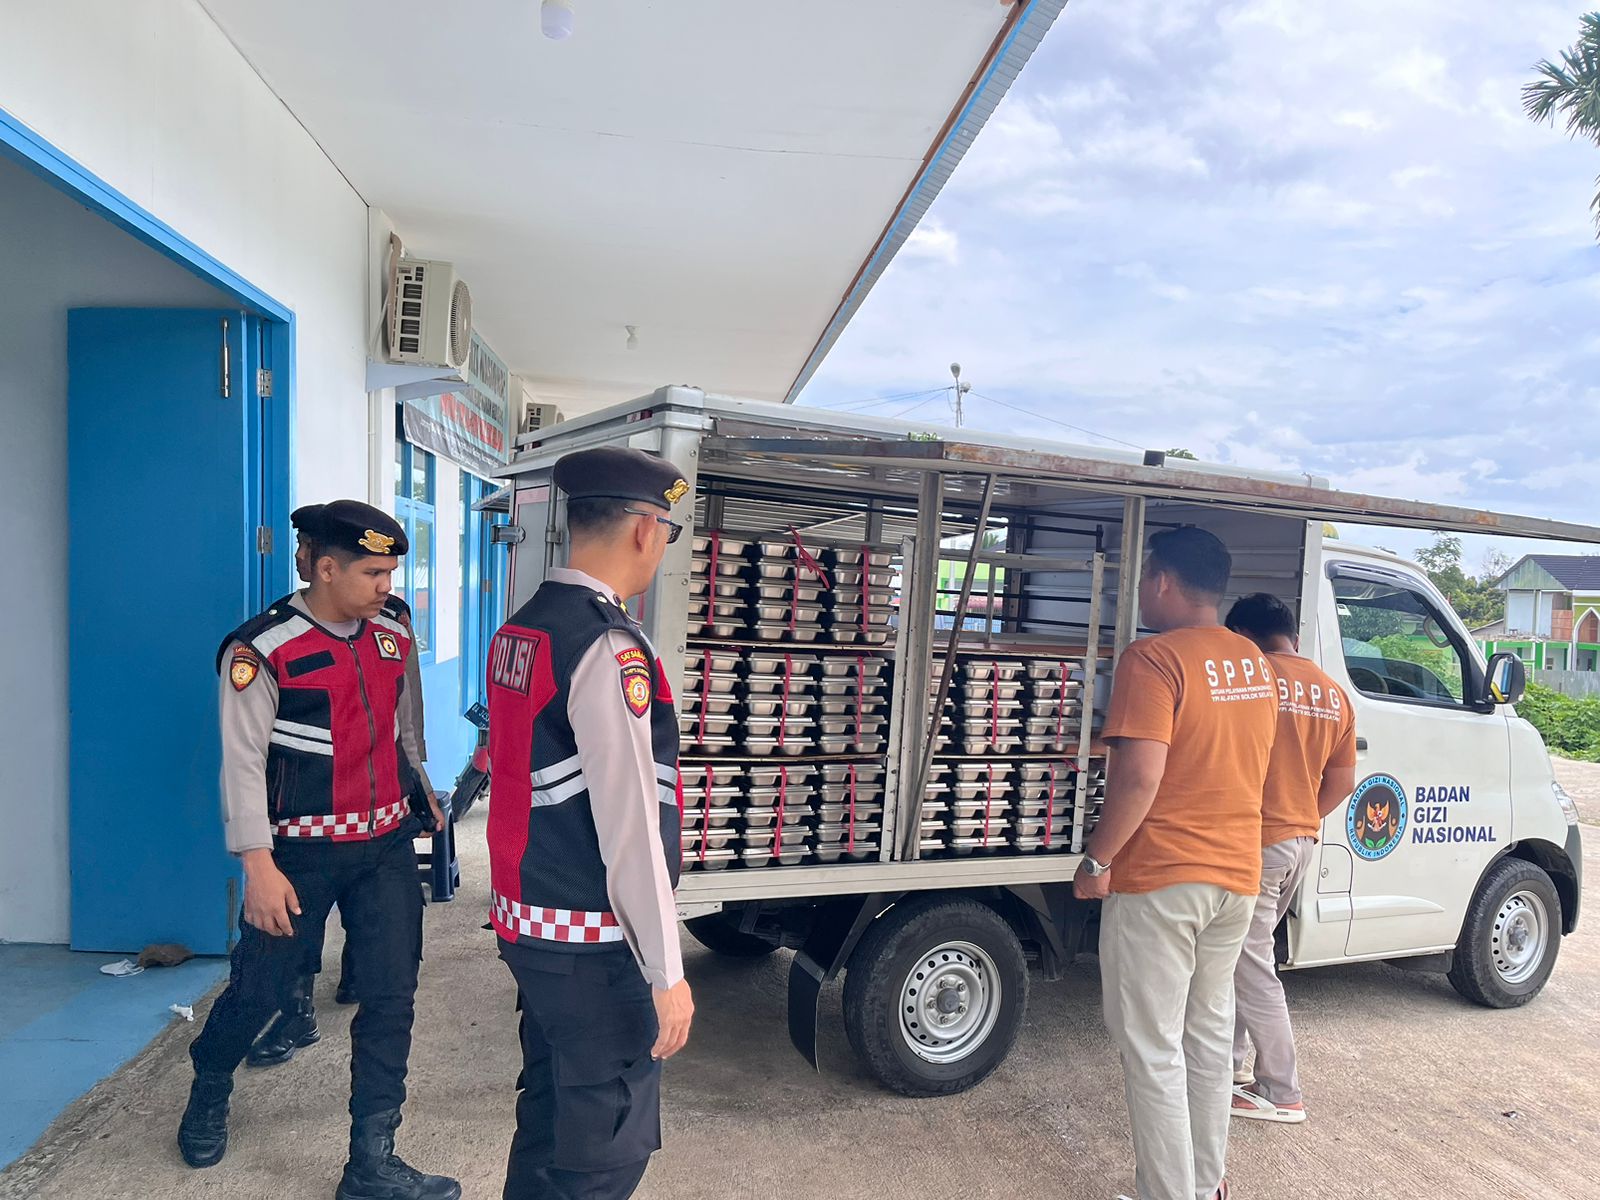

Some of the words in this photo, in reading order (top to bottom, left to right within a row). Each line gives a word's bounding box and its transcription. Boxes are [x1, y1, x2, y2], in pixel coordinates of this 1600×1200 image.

[493, 635, 535, 690] POLISI
[1205, 656, 1270, 687] SPPG
[1277, 678, 1341, 709] SPPG
[1350, 784, 1367, 810] BADAN
[1368, 776, 1381, 786] GIZI
[1382, 777, 1406, 807] NASIONAL
[1415, 785, 1470, 803] BADAN
[1413, 806, 1448, 824] GIZI
[1348, 828, 1372, 857] REPUBLIK
[1373, 826, 1403, 857] INDONESIA
[1411, 826, 1497, 844] NASIONAL
